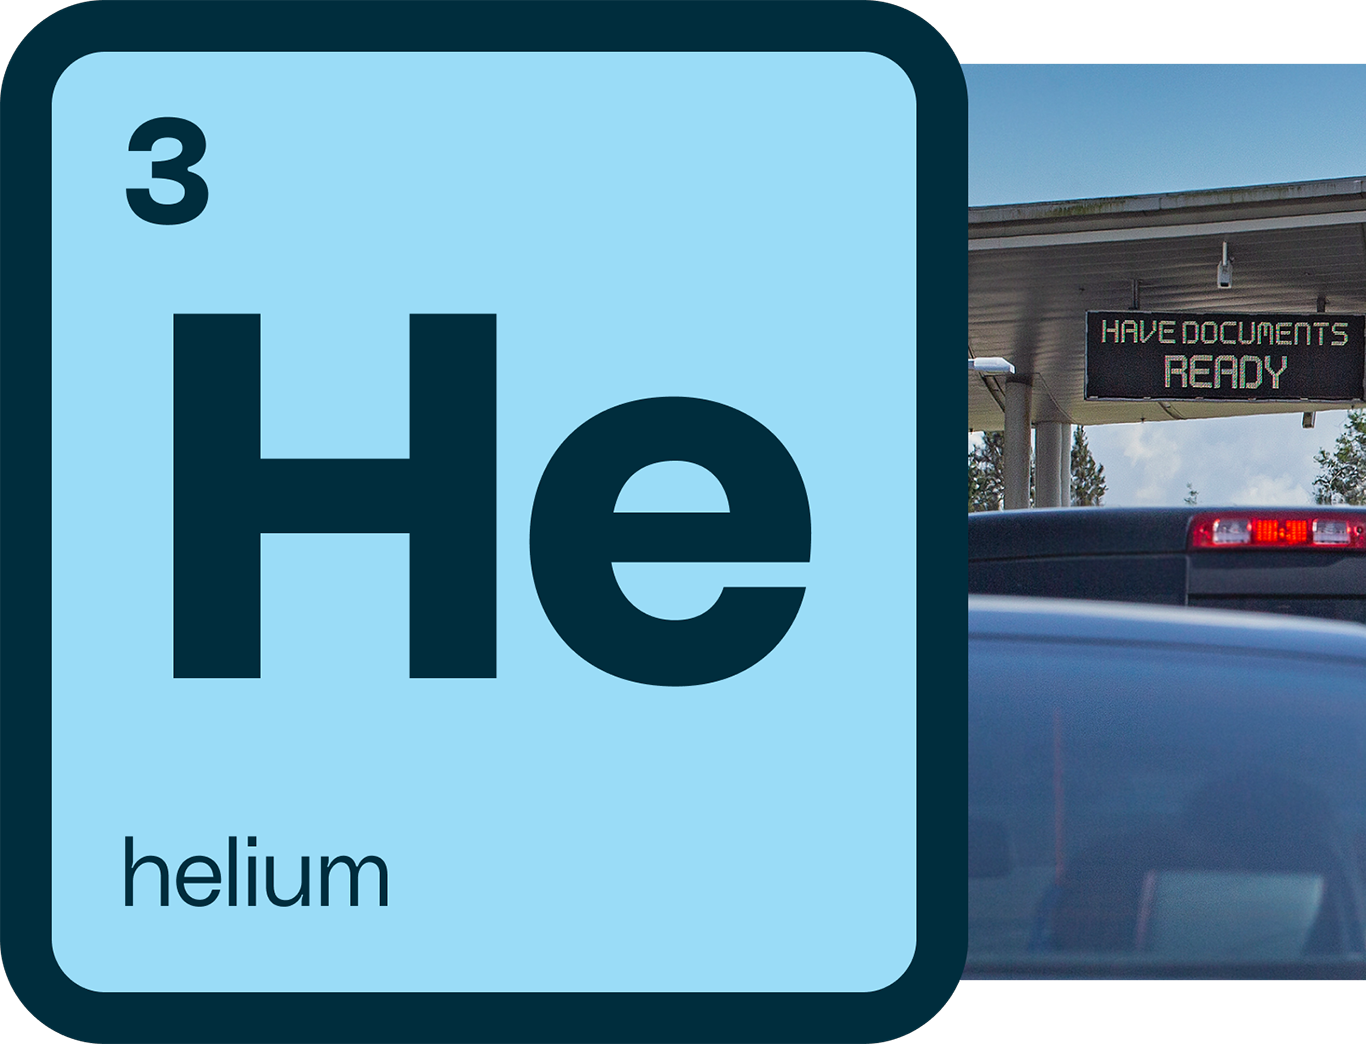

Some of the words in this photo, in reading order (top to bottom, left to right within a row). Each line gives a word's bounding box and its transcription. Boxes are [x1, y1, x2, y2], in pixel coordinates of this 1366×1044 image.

[1101, 319, 1176, 344] HAVE
[1182, 320, 1349, 346] DOCUMENTS
[1164, 355, 1288, 389] READY
